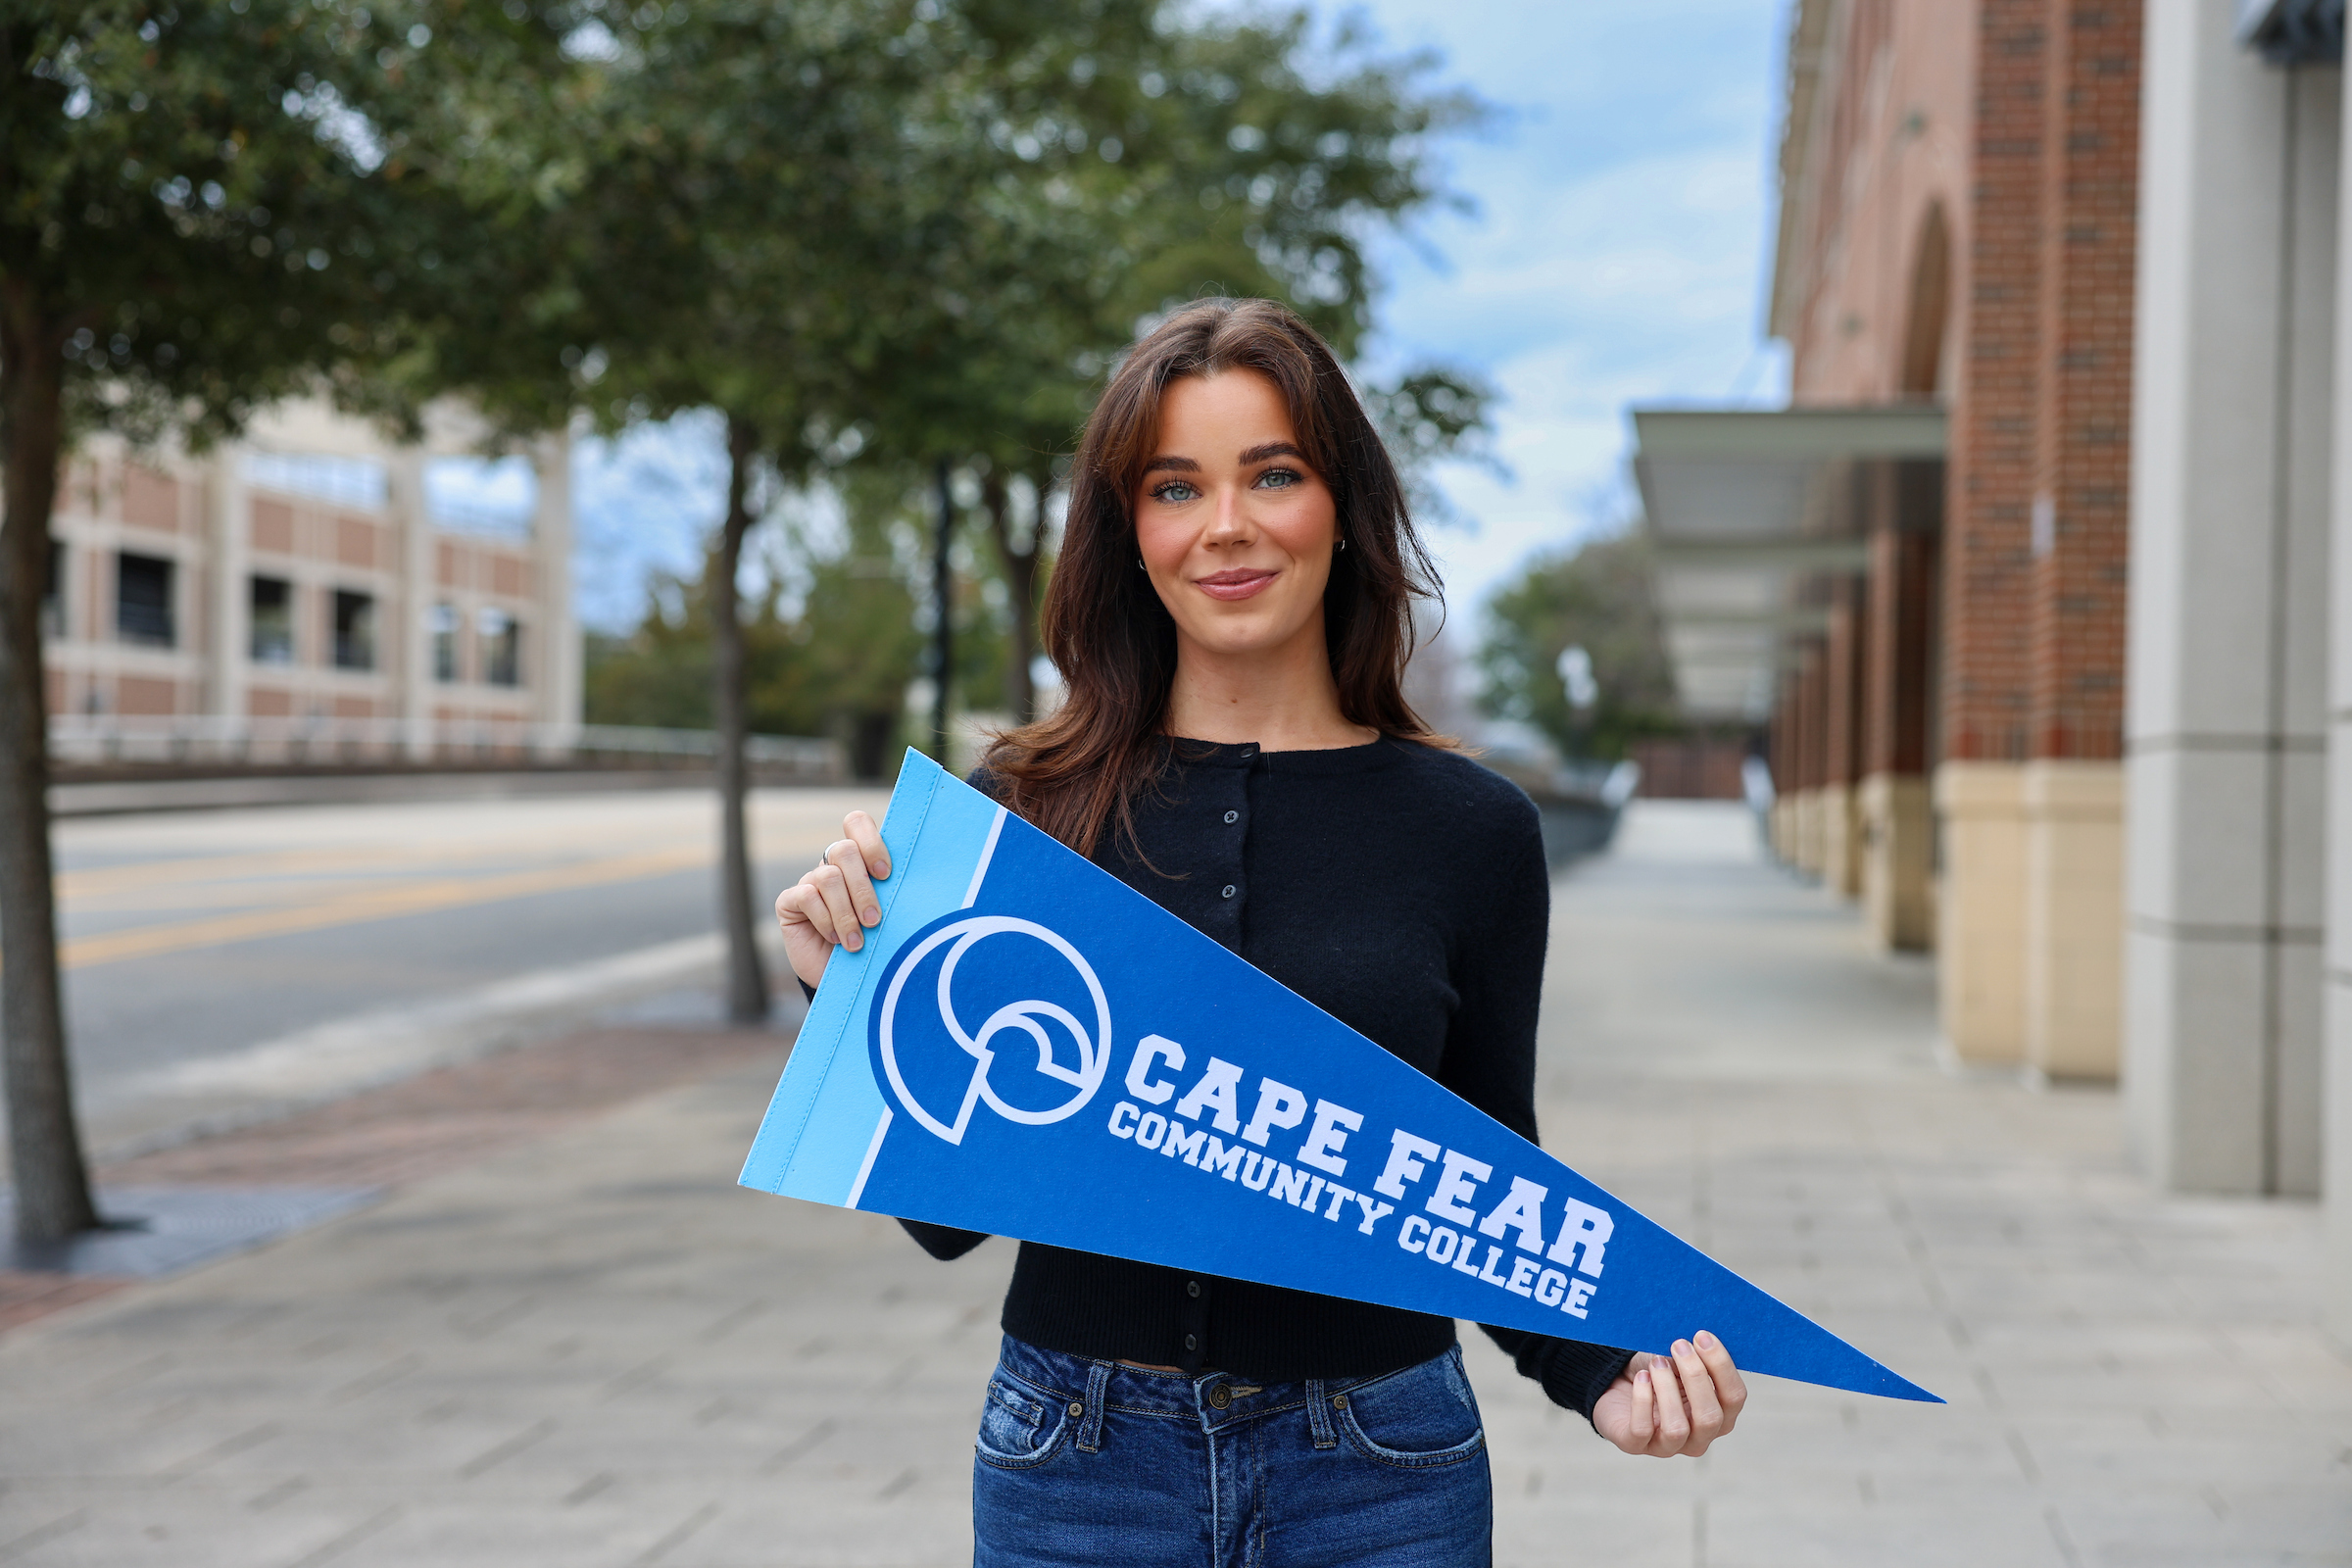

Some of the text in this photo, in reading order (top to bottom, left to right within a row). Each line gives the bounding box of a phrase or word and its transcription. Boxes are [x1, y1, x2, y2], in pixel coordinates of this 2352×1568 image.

[1107, 1101, 1597, 1320] COMMUNITY COLLEGE
[1124, 1033, 1615, 1278] CAPE FEAR
